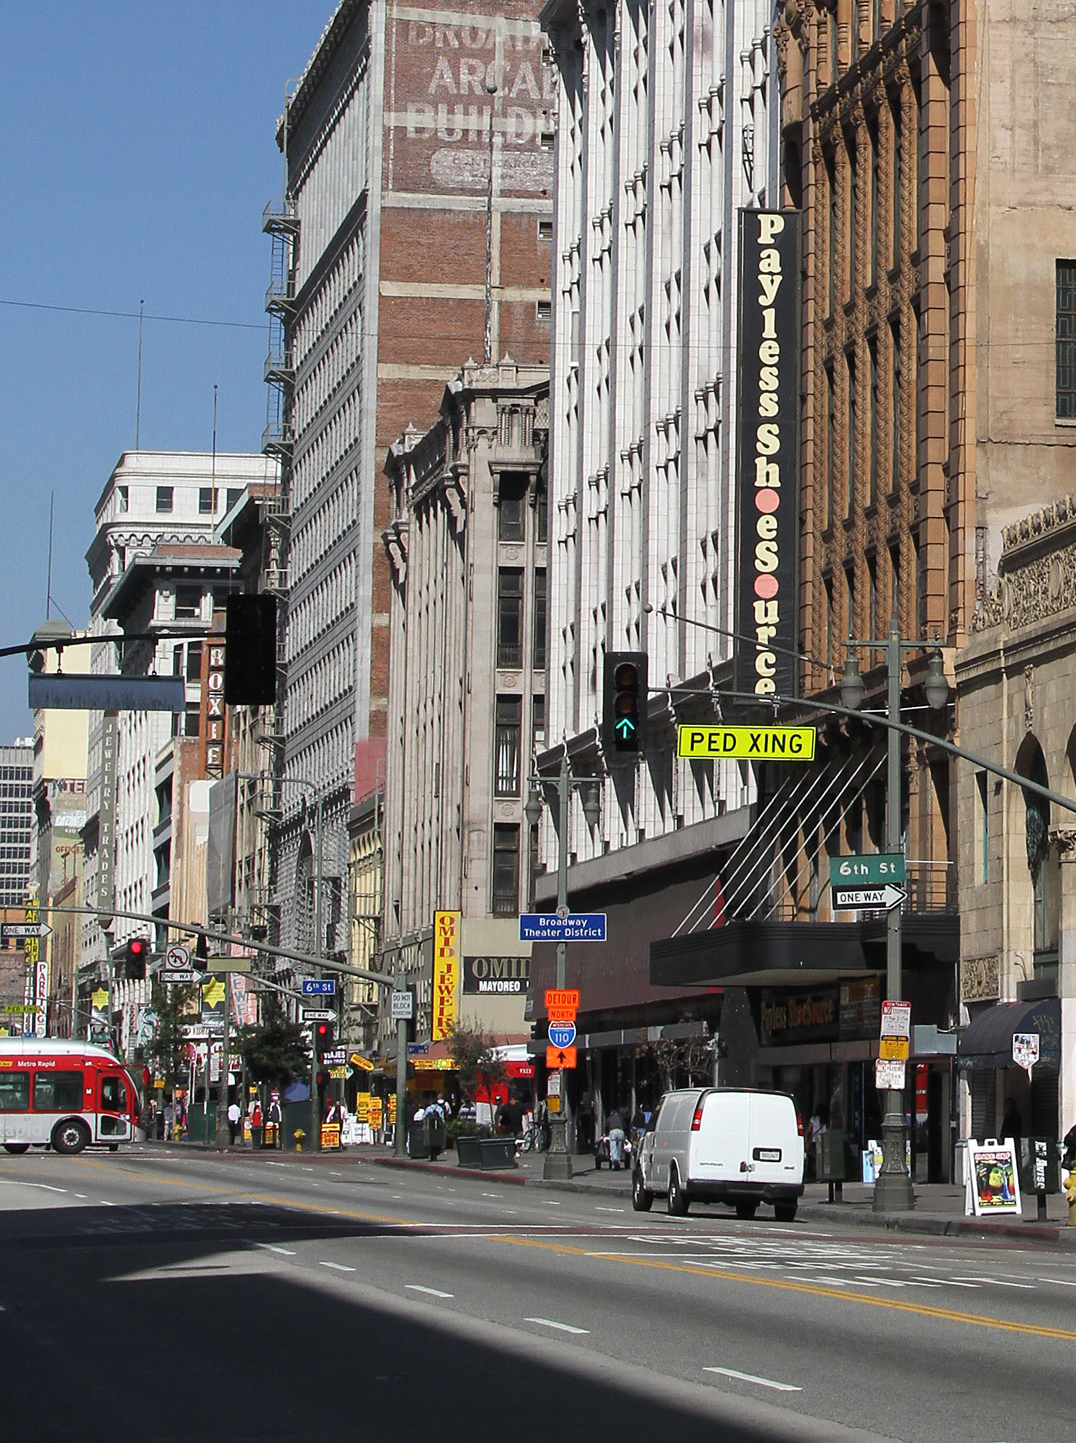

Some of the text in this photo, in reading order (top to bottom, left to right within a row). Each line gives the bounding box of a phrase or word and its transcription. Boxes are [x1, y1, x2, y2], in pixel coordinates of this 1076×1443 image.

[757, 214, 785, 417] Payless
[208, 648, 224, 765] ROXIE
[690, 732, 803, 754] PED XING
[100, 723, 113, 897] JEWELRY TRADES
[839, 861, 896, 876] 6th St
[840, 892, 885, 903] ONE WAY
[539, 918, 588, 928] Broadway
[3, 926, 40, 934] ONE WAY
[524, 928, 602, 937] Theater District
[439, 915, 455, 958] OMID
[306, 982, 332, 992] 6th St
[479, 980, 521, 992] MAYOREO
[38, 963, 46, 1023] PARKING
[547, 994, 577, 1004] DETOUR
[551, 1010, 574, 1018] NORTH
[554, 1033, 569, 1042] 110
[323, 1050, 345, 1059] VIAJES
